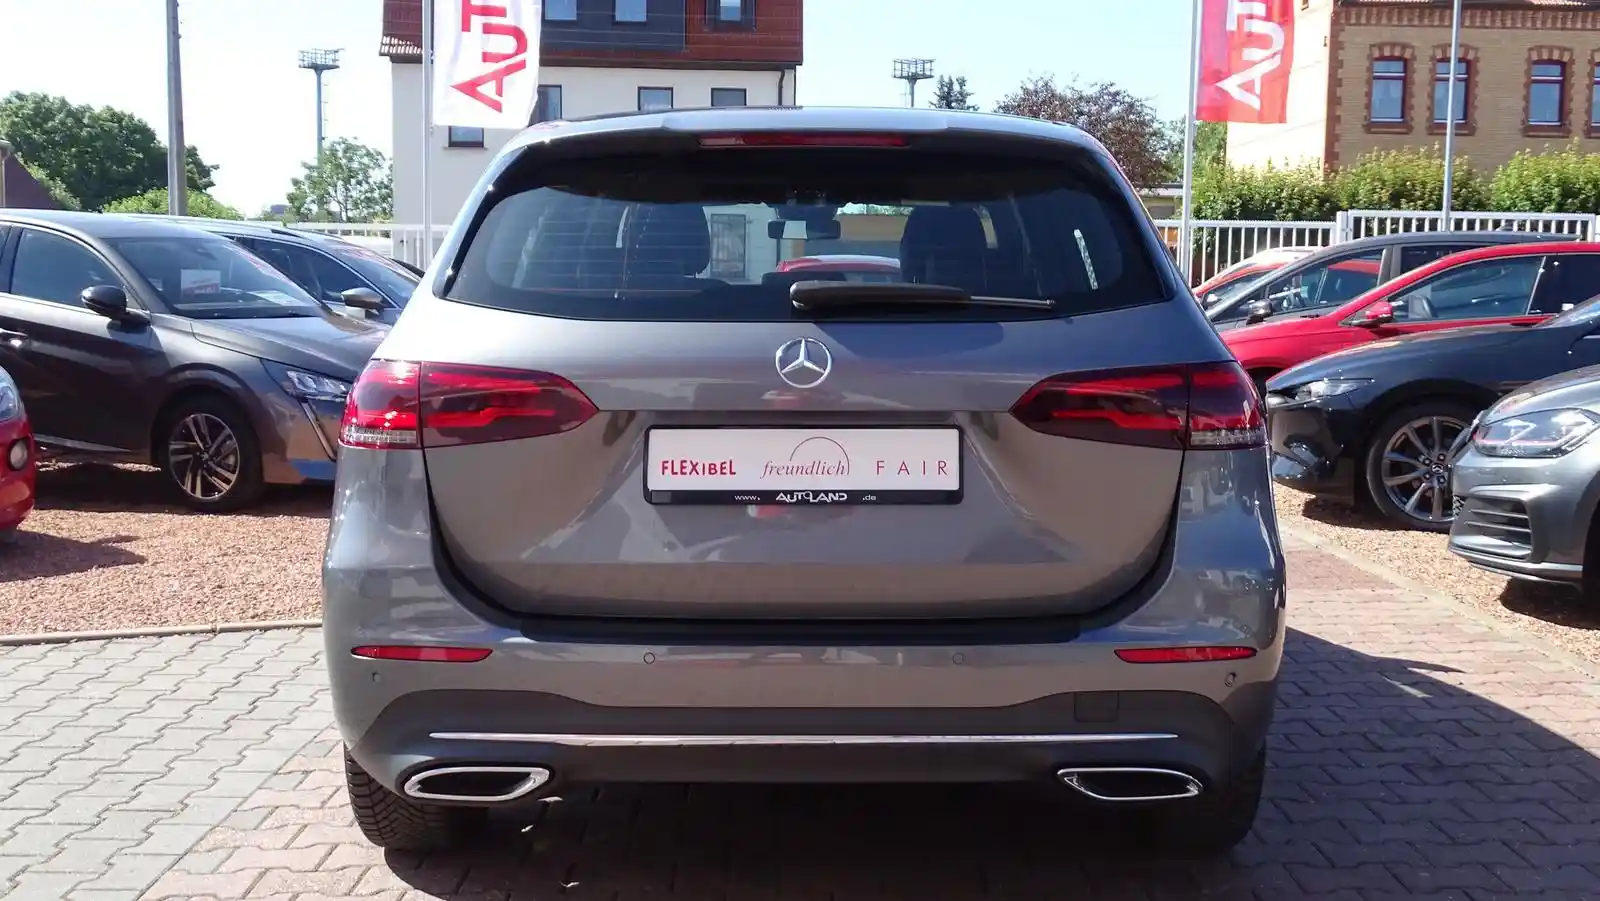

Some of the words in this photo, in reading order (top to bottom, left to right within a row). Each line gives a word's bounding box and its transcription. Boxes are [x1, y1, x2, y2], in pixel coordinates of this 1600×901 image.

[661, 459, 737, 476] FLEXIBEL
[759, 460, 846, 480] freundlich
[876, 460, 949, 476] FAIR
[776, 490, 848, 503] AUTOLAND
[862, 493, 877, 501] .de
